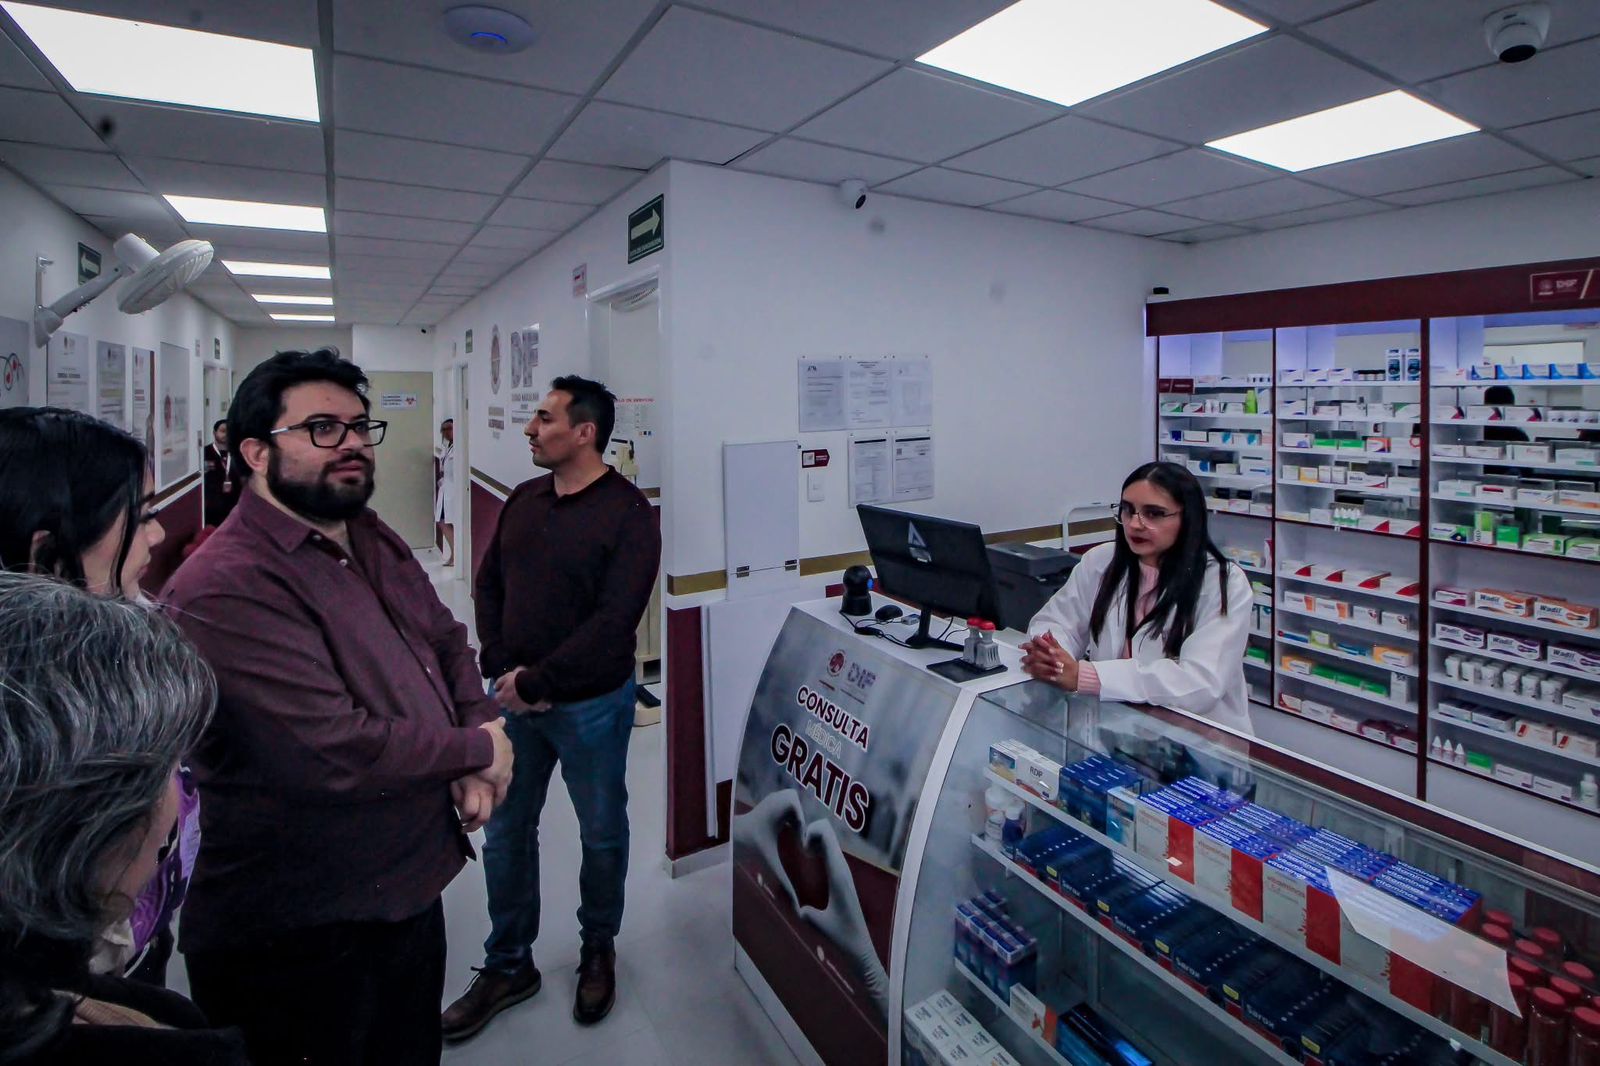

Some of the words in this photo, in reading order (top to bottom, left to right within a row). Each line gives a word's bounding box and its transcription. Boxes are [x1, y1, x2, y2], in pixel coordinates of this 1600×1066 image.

[797, 685, 869, 751] CONSULTA
[771, 723, 870, 833] GRATIS
[1376, 878, 1418, 901] vitaminas
